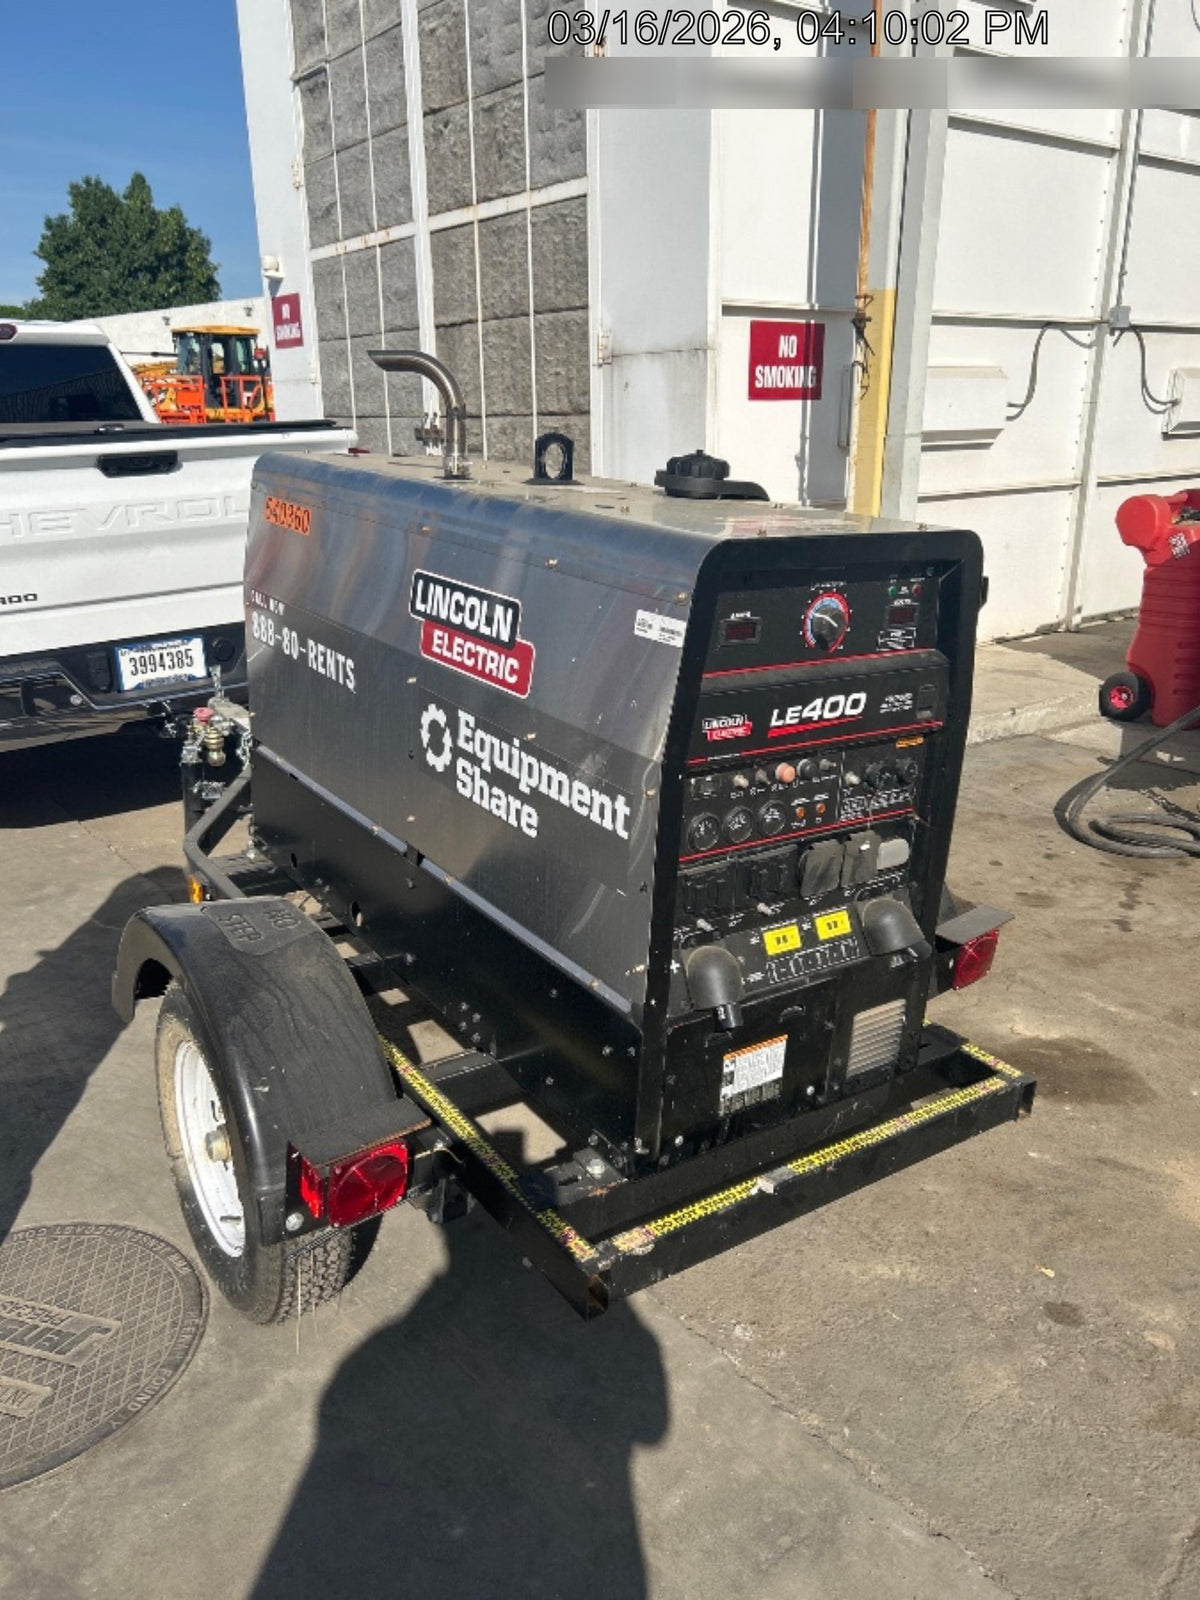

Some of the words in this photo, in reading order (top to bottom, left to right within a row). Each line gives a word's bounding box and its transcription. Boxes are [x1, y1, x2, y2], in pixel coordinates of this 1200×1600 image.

[778, 334, 798, 359] NO
[754, 364, 817, 389] SMOKING
[414, 579, 514, 644] LINCOLN
[128, 648, 195, 676] 3994385
[251, 610, 356, 693] 888-80-RENTS
[431, 629, 520, 684] ELECTRIC
[769, 691, 868, 728] LE400
[455, 756, 540, 838] Share
[456, 708, 632, 839] Equipment
